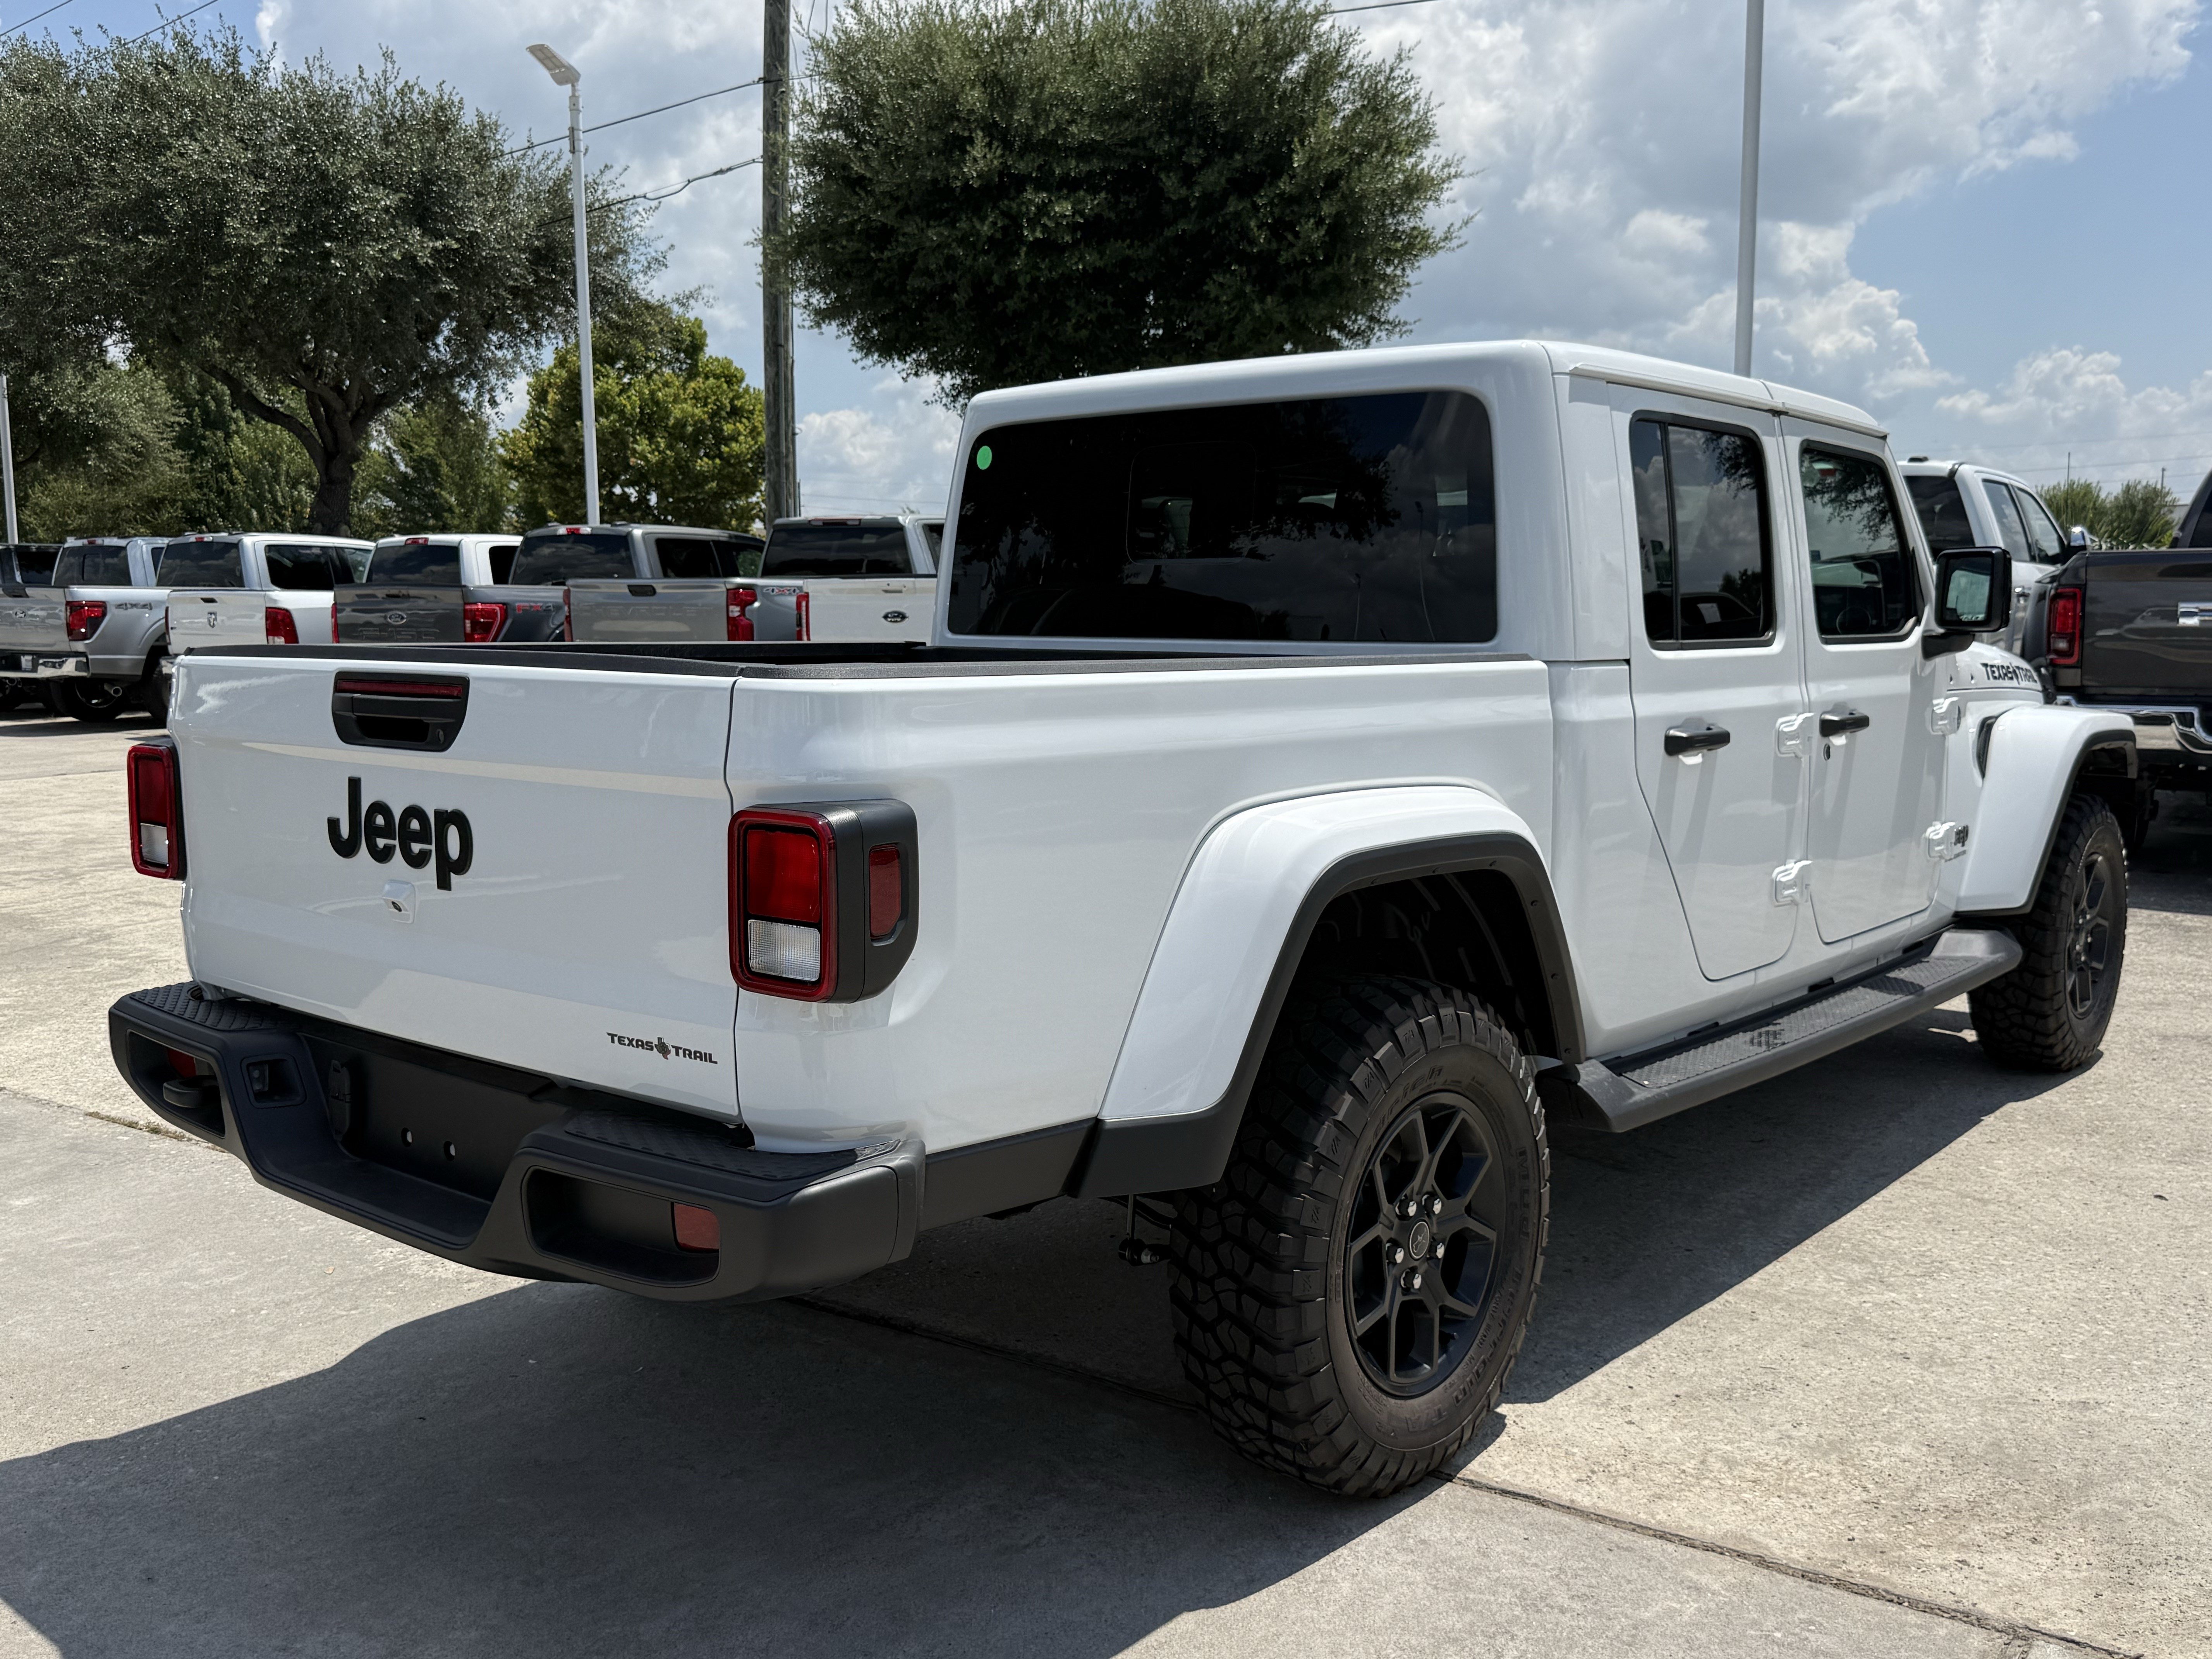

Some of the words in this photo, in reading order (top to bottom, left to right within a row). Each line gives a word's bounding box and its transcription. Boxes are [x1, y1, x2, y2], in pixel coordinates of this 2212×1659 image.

[516, 603, 554, 614] FX4
[1980, 663, 2014, 681] TEXAS
[327, 776, 473, 891] Jeep
[606, 1032, 654, 1051] TEXAS
[670, 1044, 718, 1065] TRAIL
